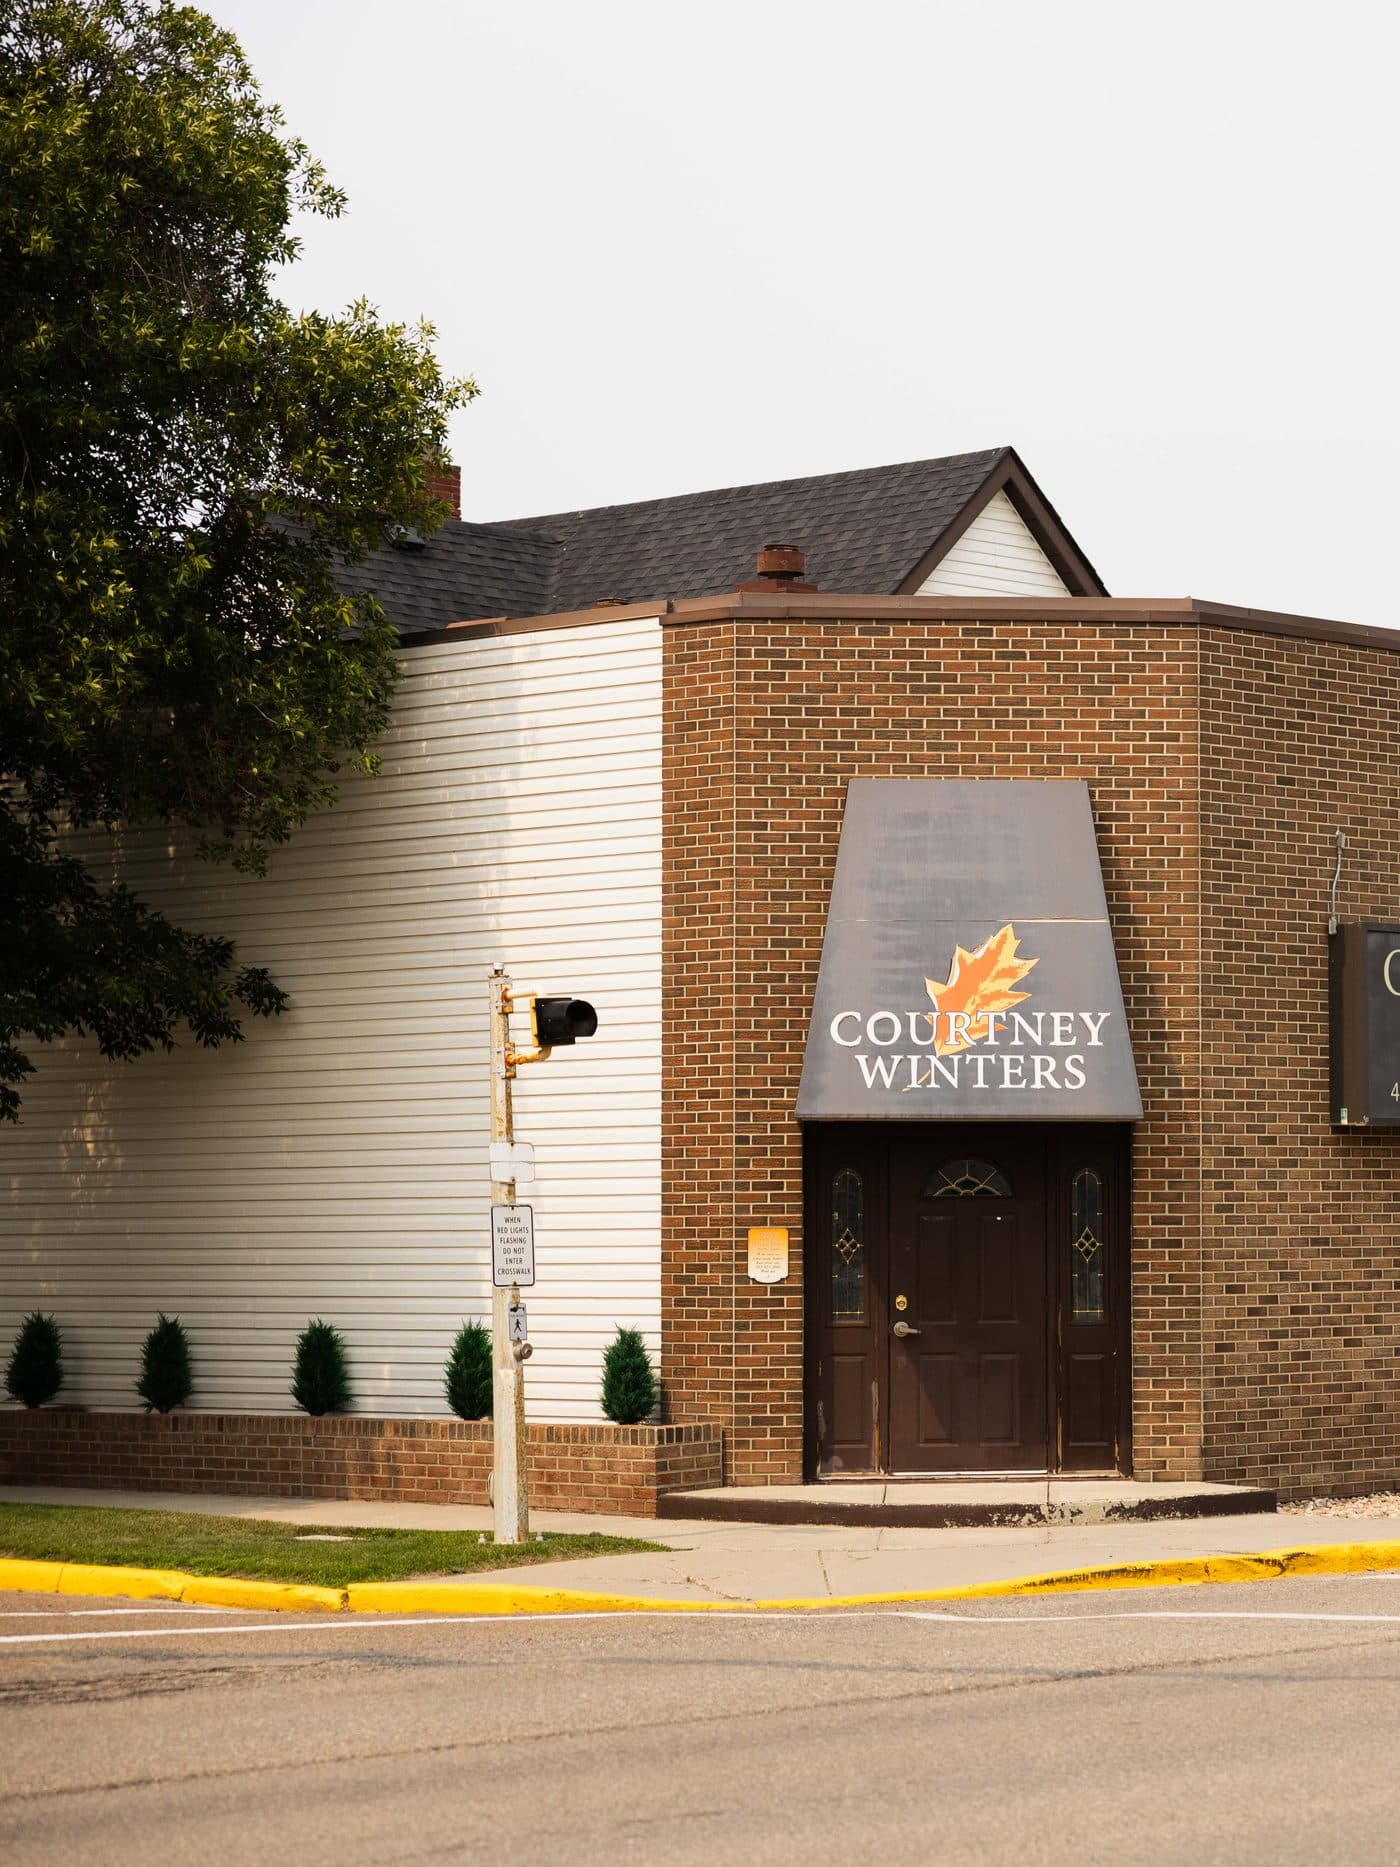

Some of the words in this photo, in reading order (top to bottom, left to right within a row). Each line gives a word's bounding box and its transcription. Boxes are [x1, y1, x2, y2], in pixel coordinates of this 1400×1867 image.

[830, 1011, 1110, 1047] COURTNEY
[855, 1054, 1086, 1089] WINTERS
[497, 1267, 531, 1275] CROSSWALK
